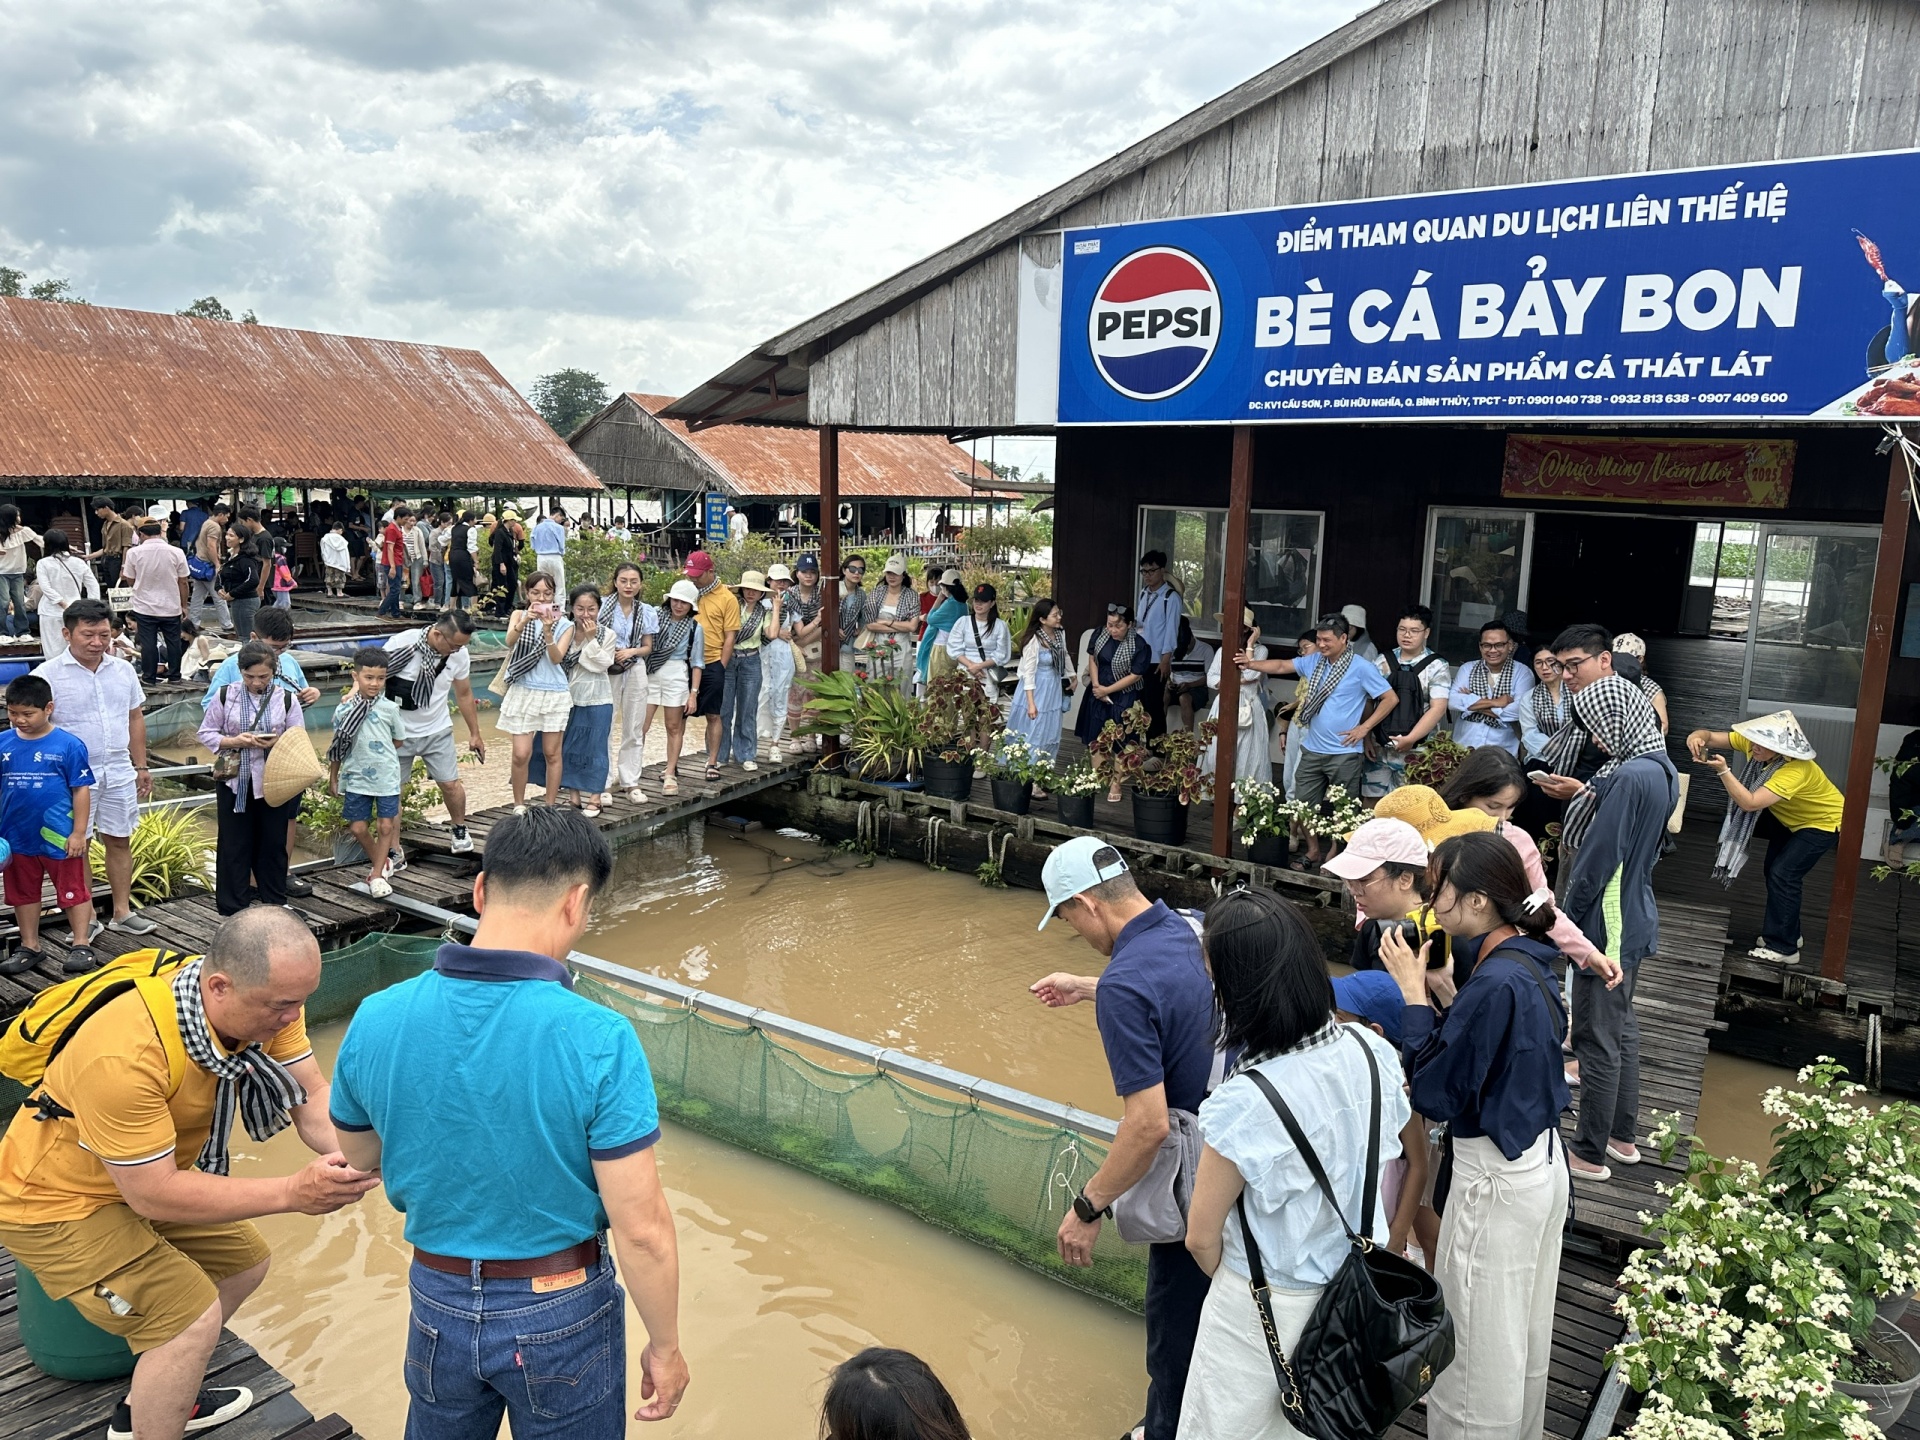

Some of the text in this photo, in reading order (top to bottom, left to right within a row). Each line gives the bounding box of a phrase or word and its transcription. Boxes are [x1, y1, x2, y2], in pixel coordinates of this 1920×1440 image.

[1276, 180, 1788, 254] ĐIỂM THAM QUAN DU LỊCH LIÊN THẾ HỆ
[1254, 254, 1803, 348] BÈ CÁ BẢY BON
[1096, 305, 1211, 342] PEPSI
[1264, 350, 1773, 388] CHUYÊN BÁN SẢN PHẨM CÁ THÁT LÁT
[1248, 401, 1264, 410] ĐC:
[1264, 400, 1282, 410] KV1
[1302, 399, 1323, 410] SƠN,
[1324, 399, 1333, 408] P.
[1334, 398, 1350, 408] BÙI
[1350, 397, 1371, 408] HỮU
[1371, 396, 1404, 409] NGHĨA,
[1416, 396, 1440, 407] BÌNH
[1440, 394, 1470, 407] THỦY,
[1472, 396, 1501, 406] TPCT
[1508, 396, 1526, 406] ĐT:
[1526, 395, 1555, 405] 0901
[1554, 395, 1579, 405] 040
[1580, 394, 1603, 404] 738
[1609, 394, 1642, 404] 0932
[1642, 394, 1664, 404] 813
[1664, 394, 1690, 404] 638
[1697, 393, 1732, 403] 0907
[1732, 393, 1760, 403] 409
[1760, 392, 1789, 403] 600
[1523, 448, 1597, 488] Chúc
[1593, 453, 1645, 486] Mừng
[1644, 451, 1698, 488] Năm
[1751, 467, 1778, 482] 2025
